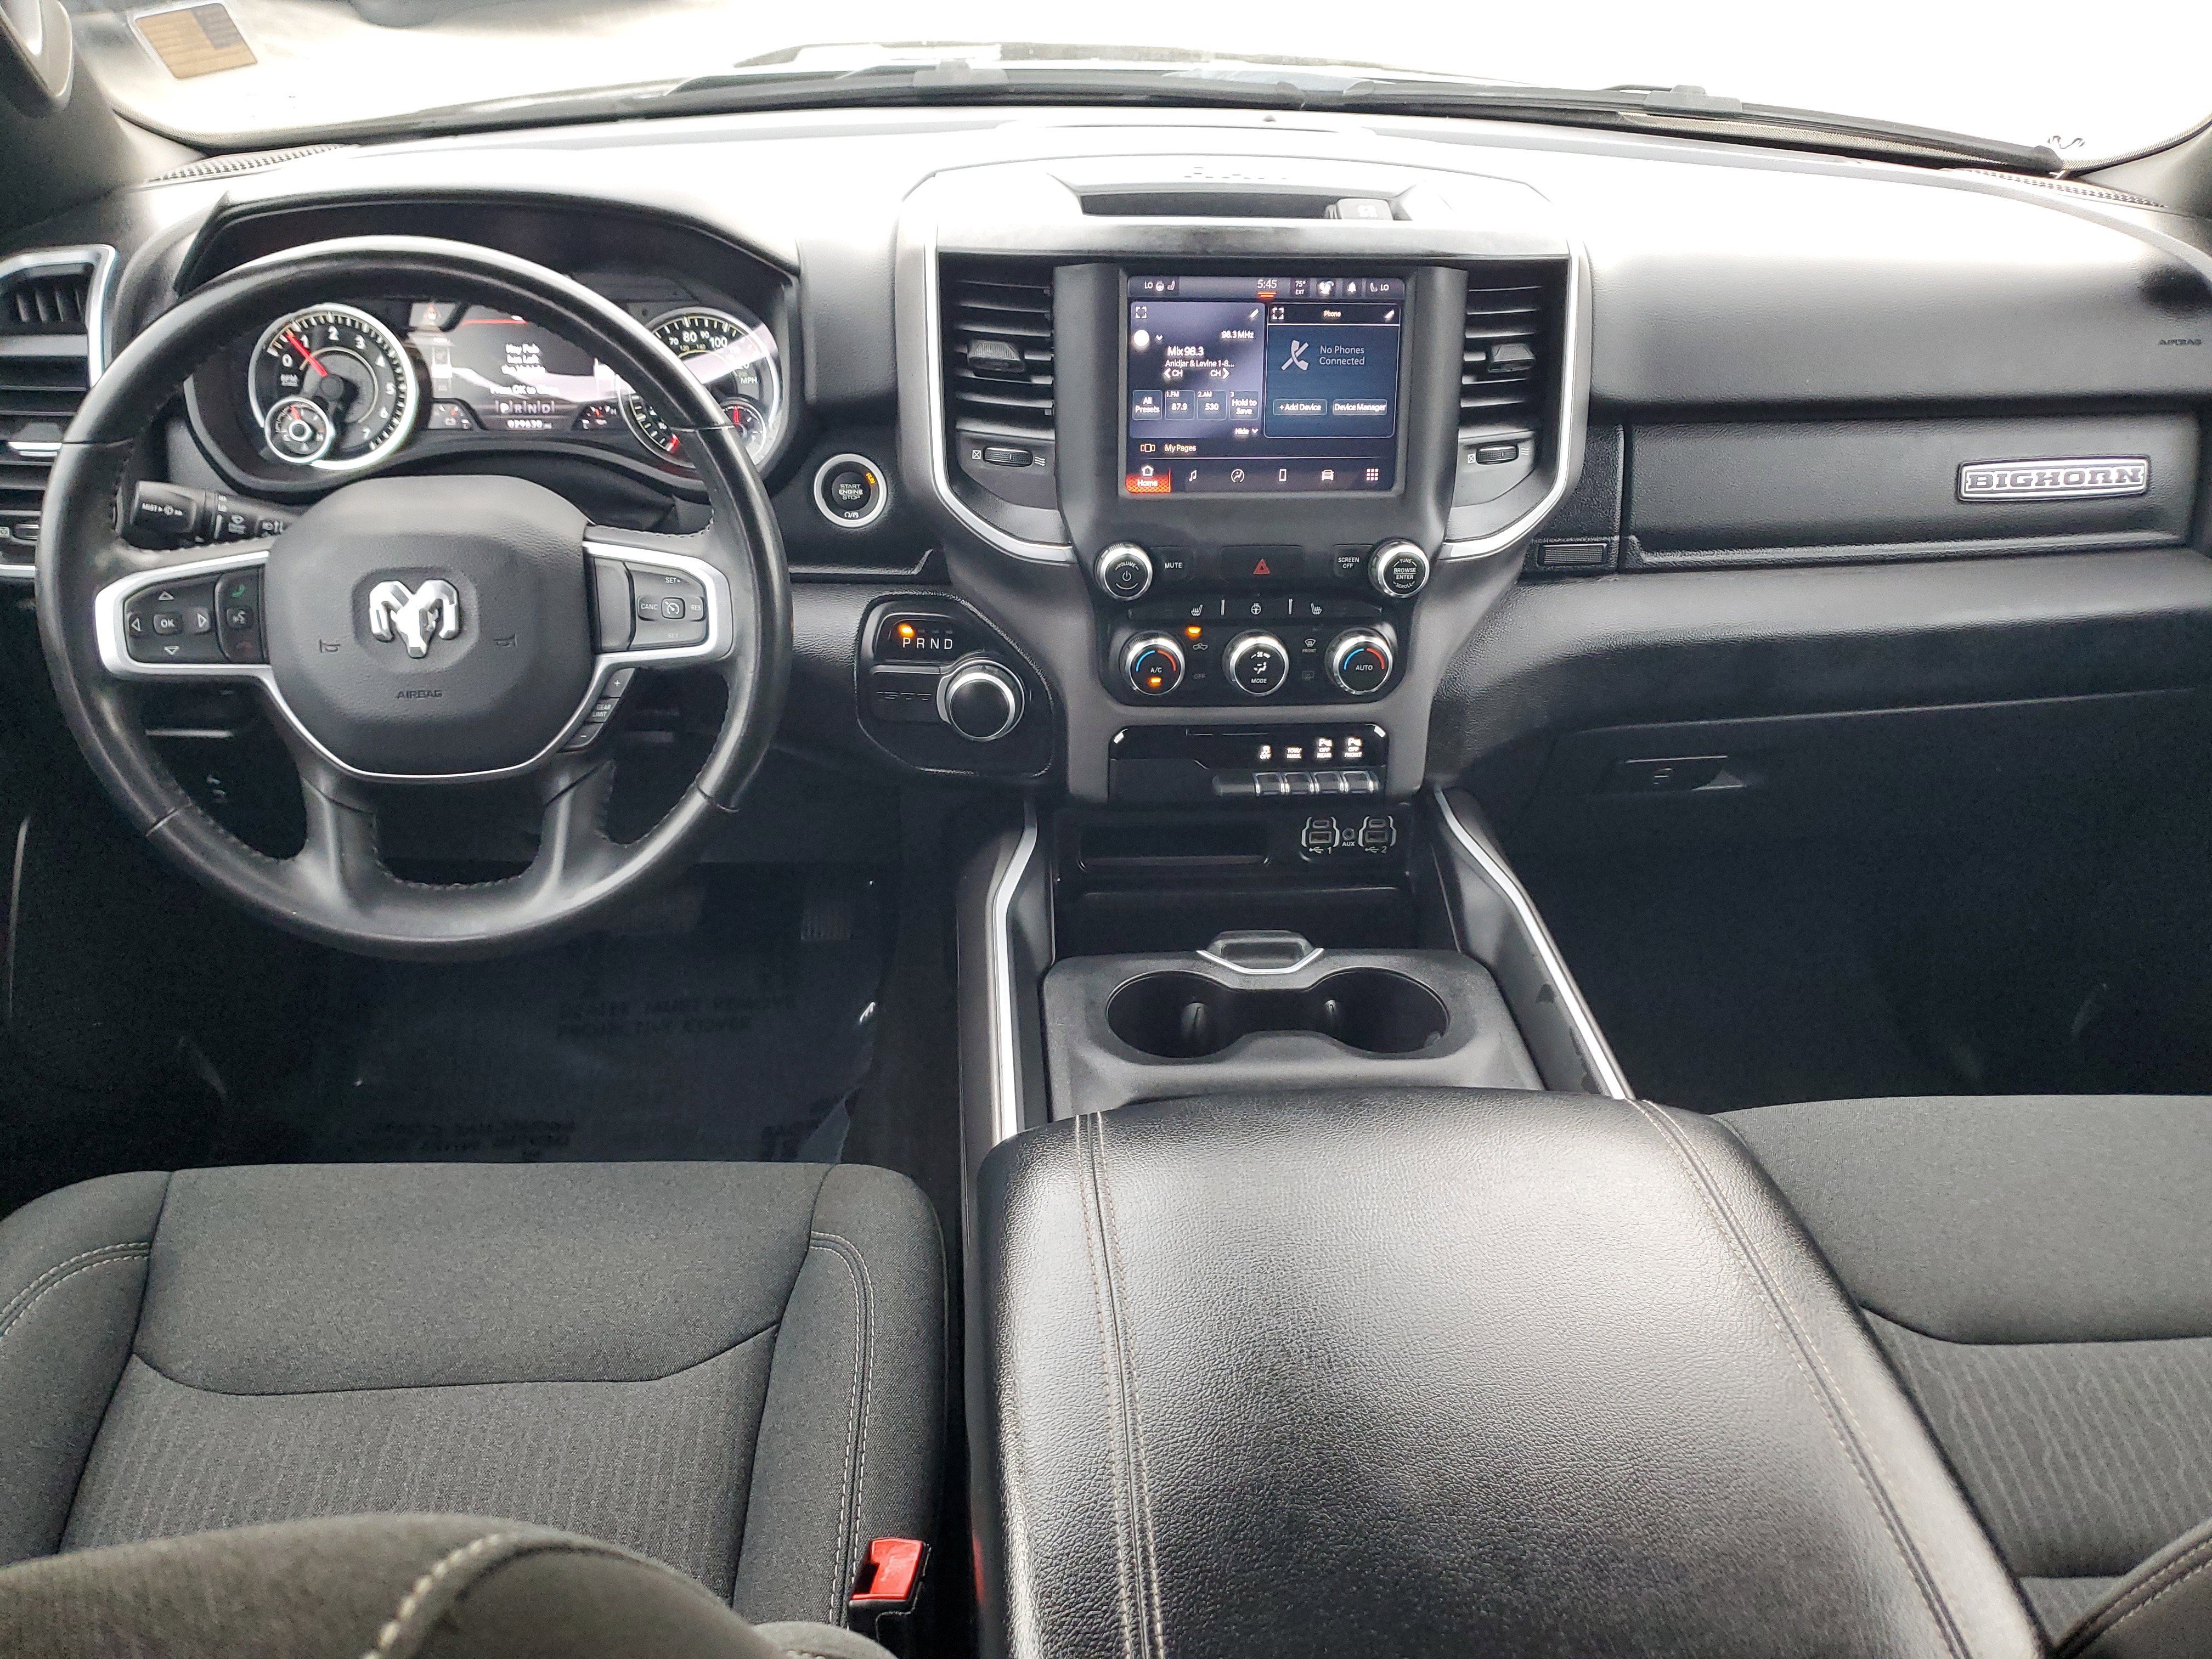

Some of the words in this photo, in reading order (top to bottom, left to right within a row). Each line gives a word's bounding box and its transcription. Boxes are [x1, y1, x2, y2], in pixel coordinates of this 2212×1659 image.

[1257, 279, 1277, 289] 5:45
[328, 325, 340, 341] 2
[682, 330, 698, 343] 80
[699, 330, 710, 339] 90
[1221, 330, 1237, 338] 98.3
[1238, 330, 1254, 338] MHz
[301, 334, 310, 348] 1
[354, 334, 366, 349] 3
[669, 336, 679, 346] 70
[709, 336, 728, 348] 100
[1167, 346, 1183, 356] Mix
[1184, 346, 1204, 356] 98.3
[1320, 346, 1333, 354] No
[1334, 345, 1364, 354] Phones
[282, 353, 293, 368] 0
[1319, 357, 1365, 365] Connected
[1172, 369, 1183, 377] CH
[1210, 369, 1221, 377] CH
[1171, 403, 1188, 411] 87.9
[1232, 398, 1249, 407] Hold
[527, 404, 537, 414] N
[541, 404, 551, 414] D
[1357, 403, 1386, 412] Manager
[1165, 444, 1176, 453] My
[1176, 444, 1197, 453] Pages
[1137, 479, 1158, 487] Home
[1968, 468, 2141, 489] BIGHORN
[161, 620, 176, 629] OK
[902, 637, 911, 648] P
[916, 637, 925, 649] R
[930, 637, 939, 650] N
[944, 639, 953, 650] D
[396, 690, 443, 699] AIRBAG
[1327, 847, 1332, 855] 1
[1381, 845, 1387, 854] 2
